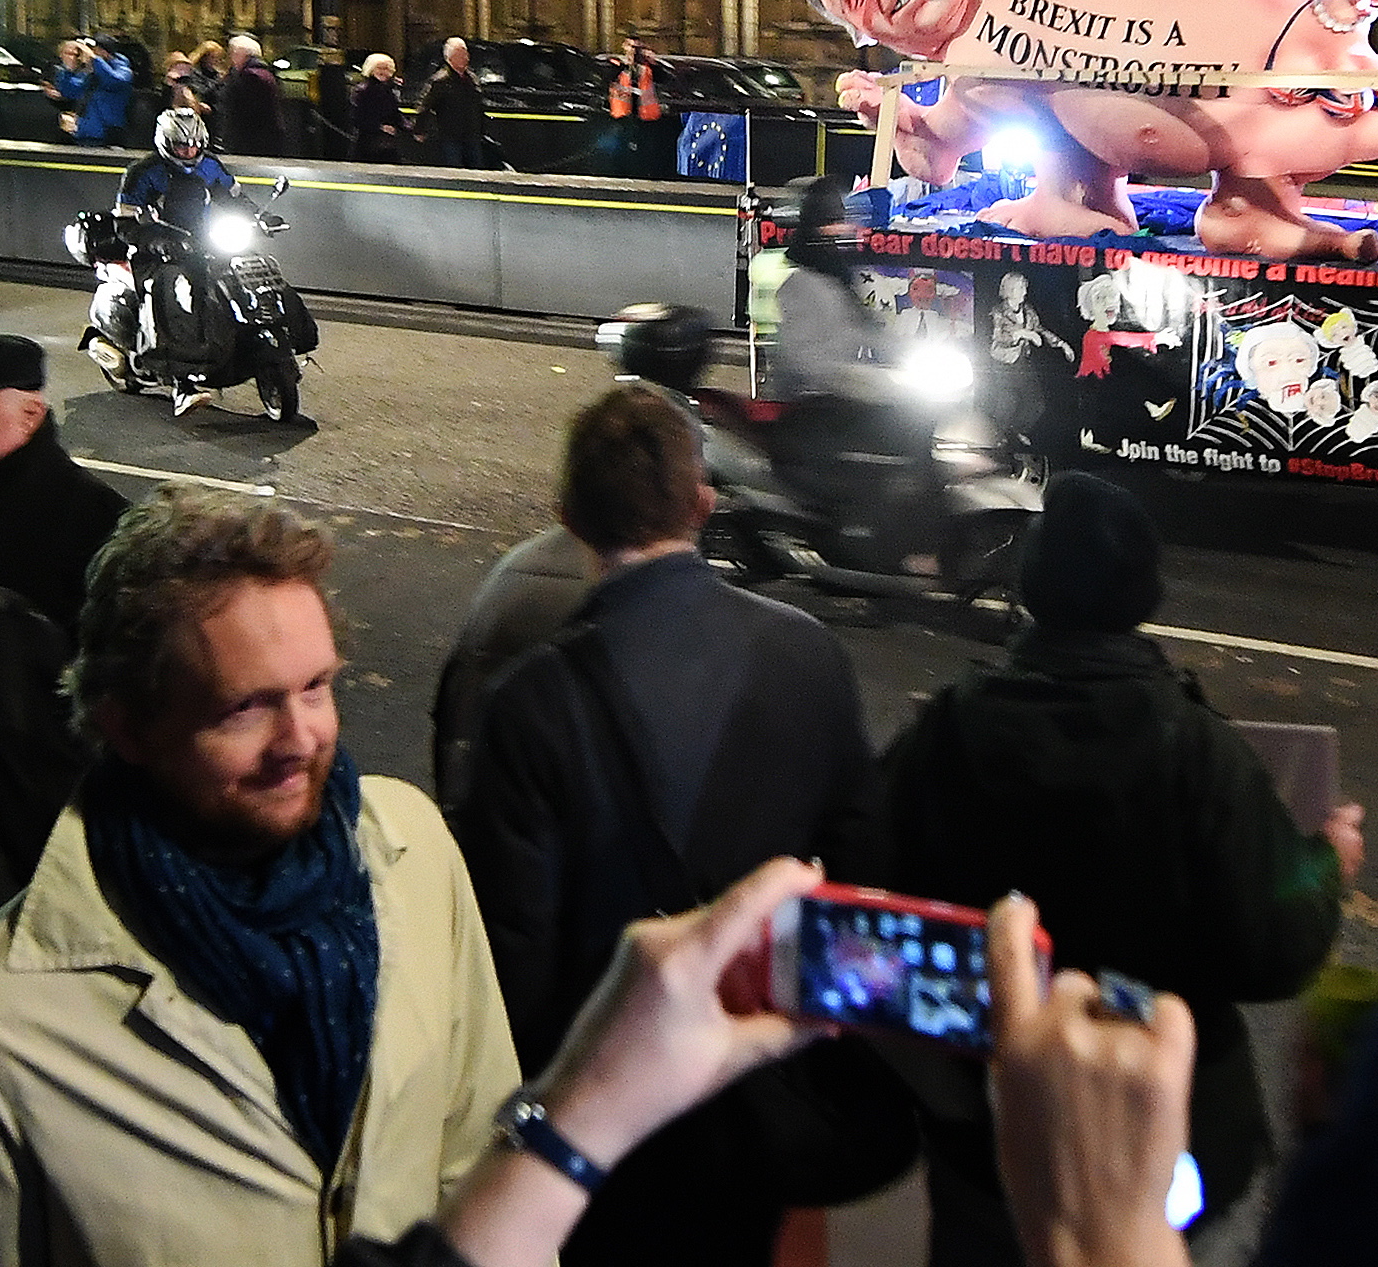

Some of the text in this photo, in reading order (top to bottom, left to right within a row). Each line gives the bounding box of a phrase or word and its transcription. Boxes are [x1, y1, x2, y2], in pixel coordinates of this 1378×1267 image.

[976, 12, 1240, 99] MONSTROSITY
[1122, 19, 1154, 46] IS
[1163, 20, 1186, 47] A
[857, 227, 914, 255] Fear
[921, 231, 1022, 263] doesn't
[1029, 242, 1096, 268] have
[1104, 247, 1133, 270] to
[1266, 263, 1287, 282] a
[1116, 438, 1160, 463] Join
[1165, 443, 1199, 465] the
[1203, 448, 1255, 473] fight
[1258, 453, 1281, 473] to
